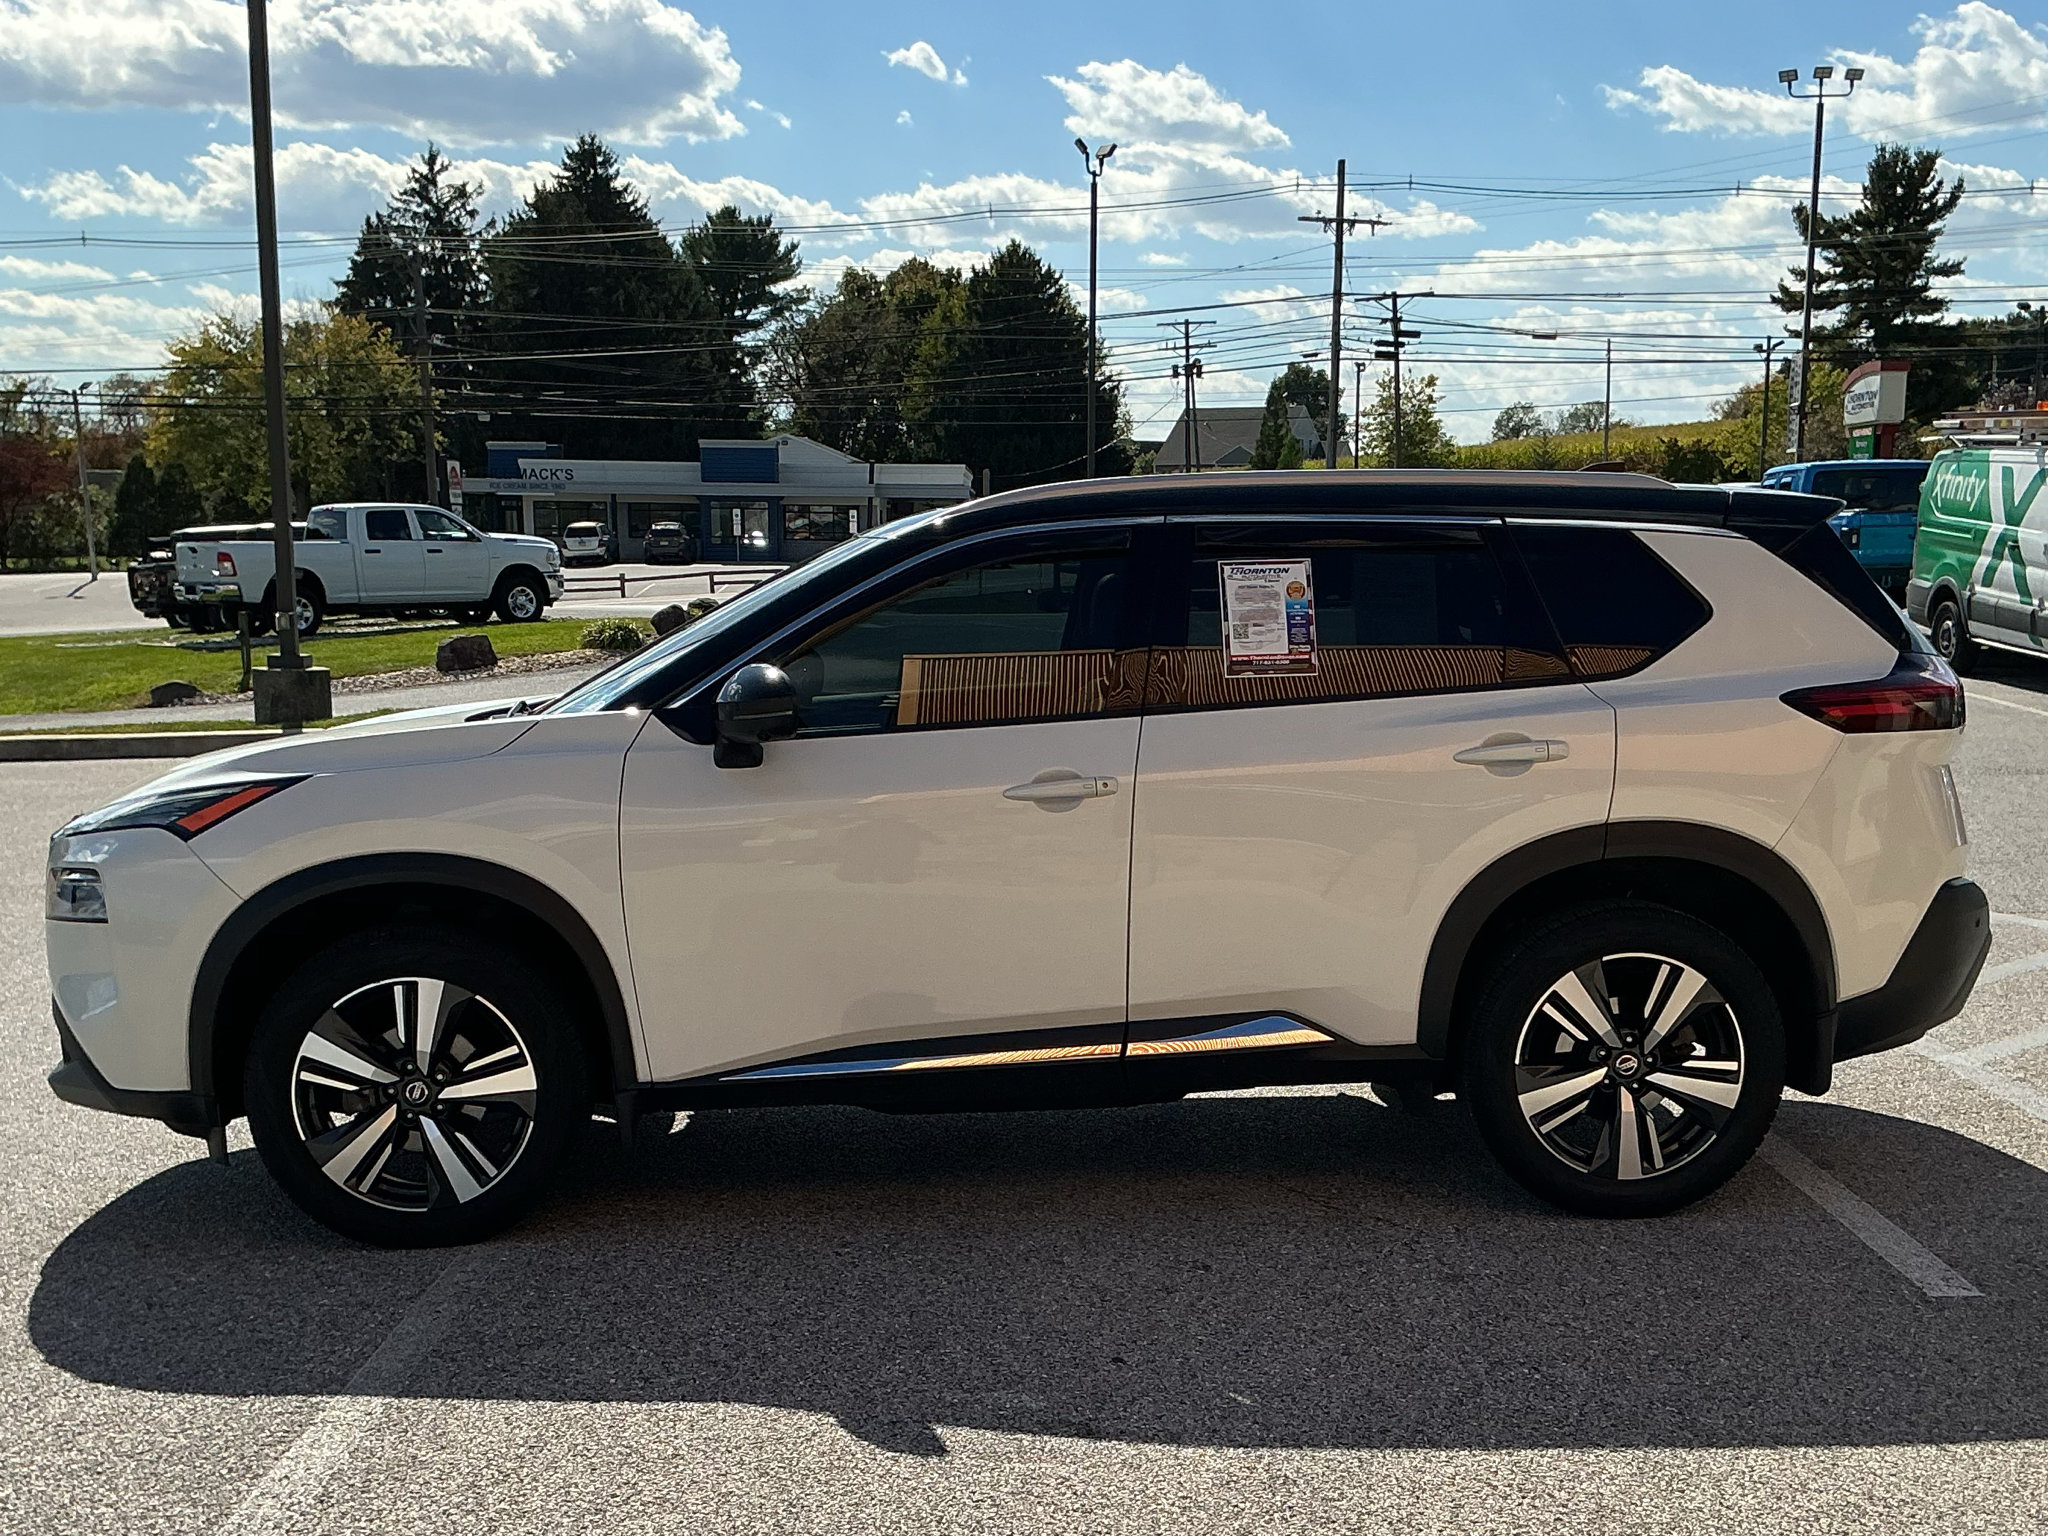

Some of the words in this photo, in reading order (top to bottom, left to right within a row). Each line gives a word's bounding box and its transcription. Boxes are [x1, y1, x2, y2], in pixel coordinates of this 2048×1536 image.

[520, 468, 574, 480] MACK'S
[1932, 463, 1986, 512] xfinity
[1230, 567, 1290, 575] THORNTON
